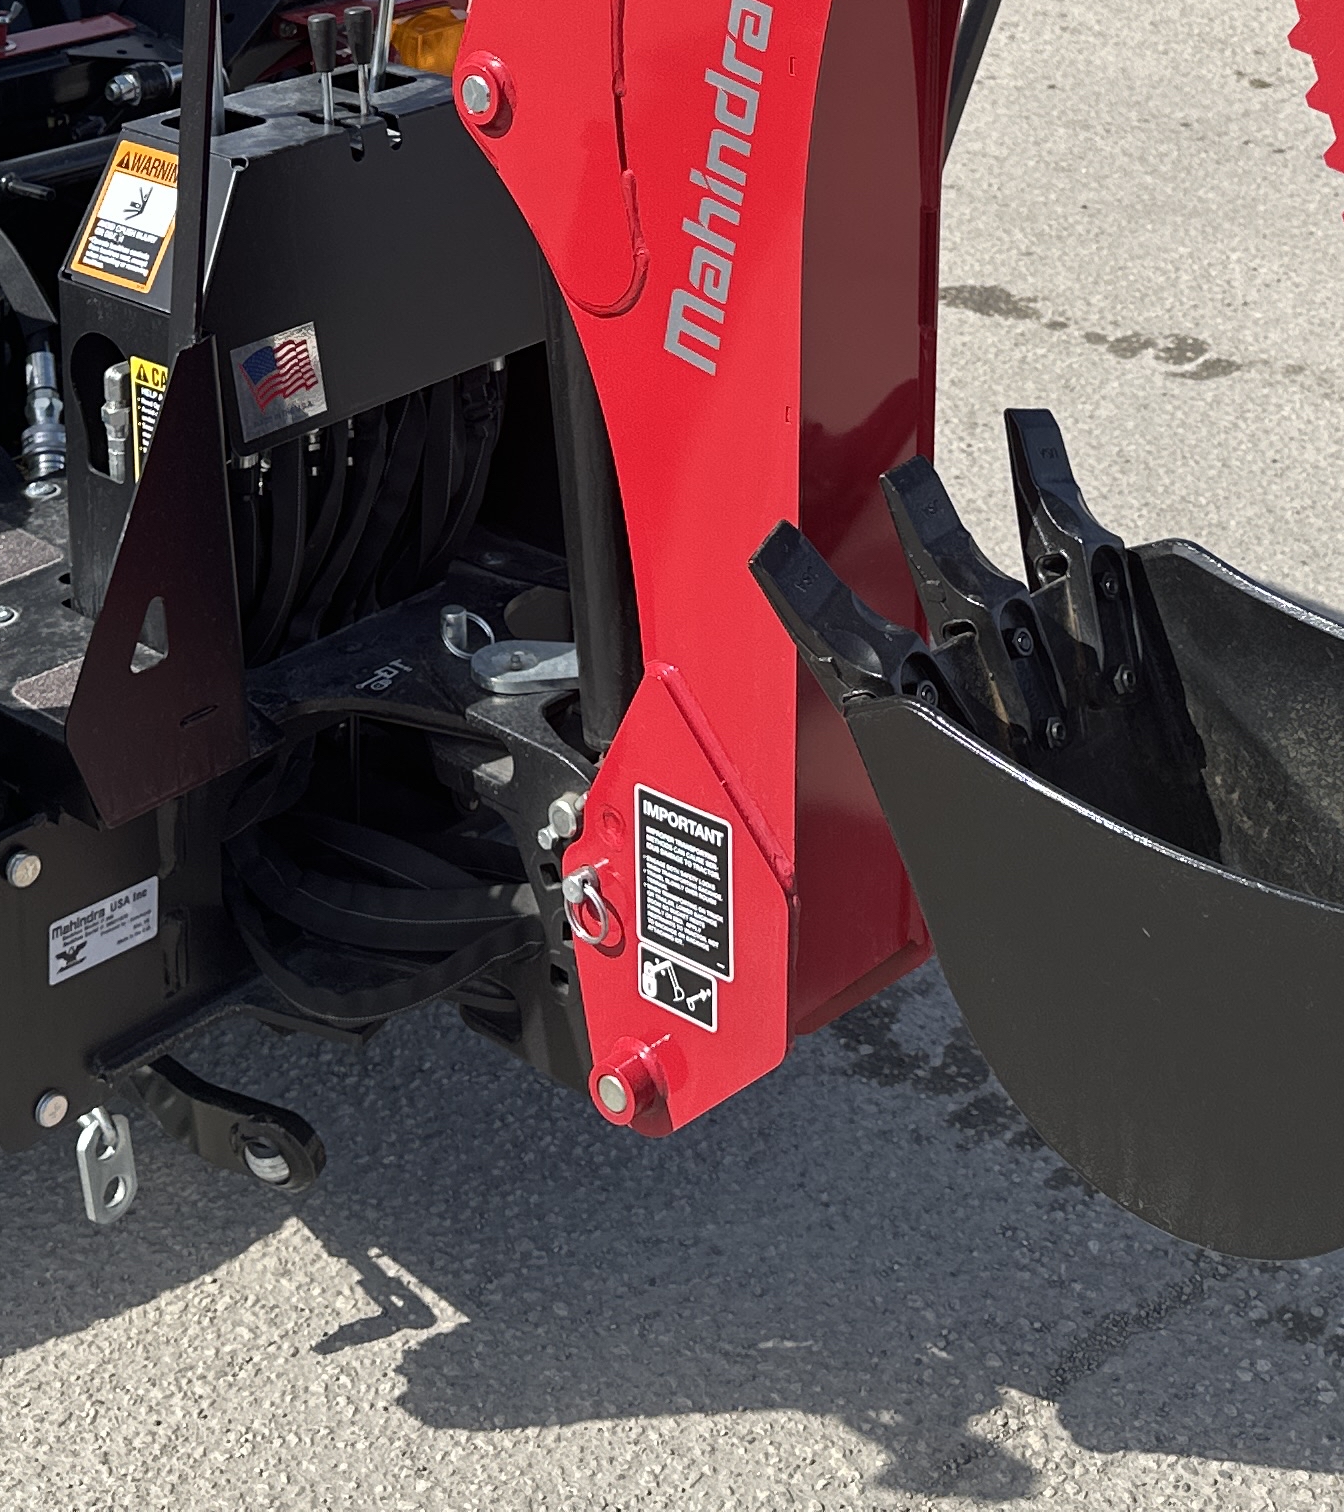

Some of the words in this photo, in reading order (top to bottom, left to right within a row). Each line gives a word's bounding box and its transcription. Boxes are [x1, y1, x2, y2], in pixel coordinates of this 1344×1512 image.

[130, 152, 179, 184] WARNIN
[642, 798, 723, 849] IMPORTANT
[110, 895, 130, 912] USA
[133, 889, 147, 902] Inc
